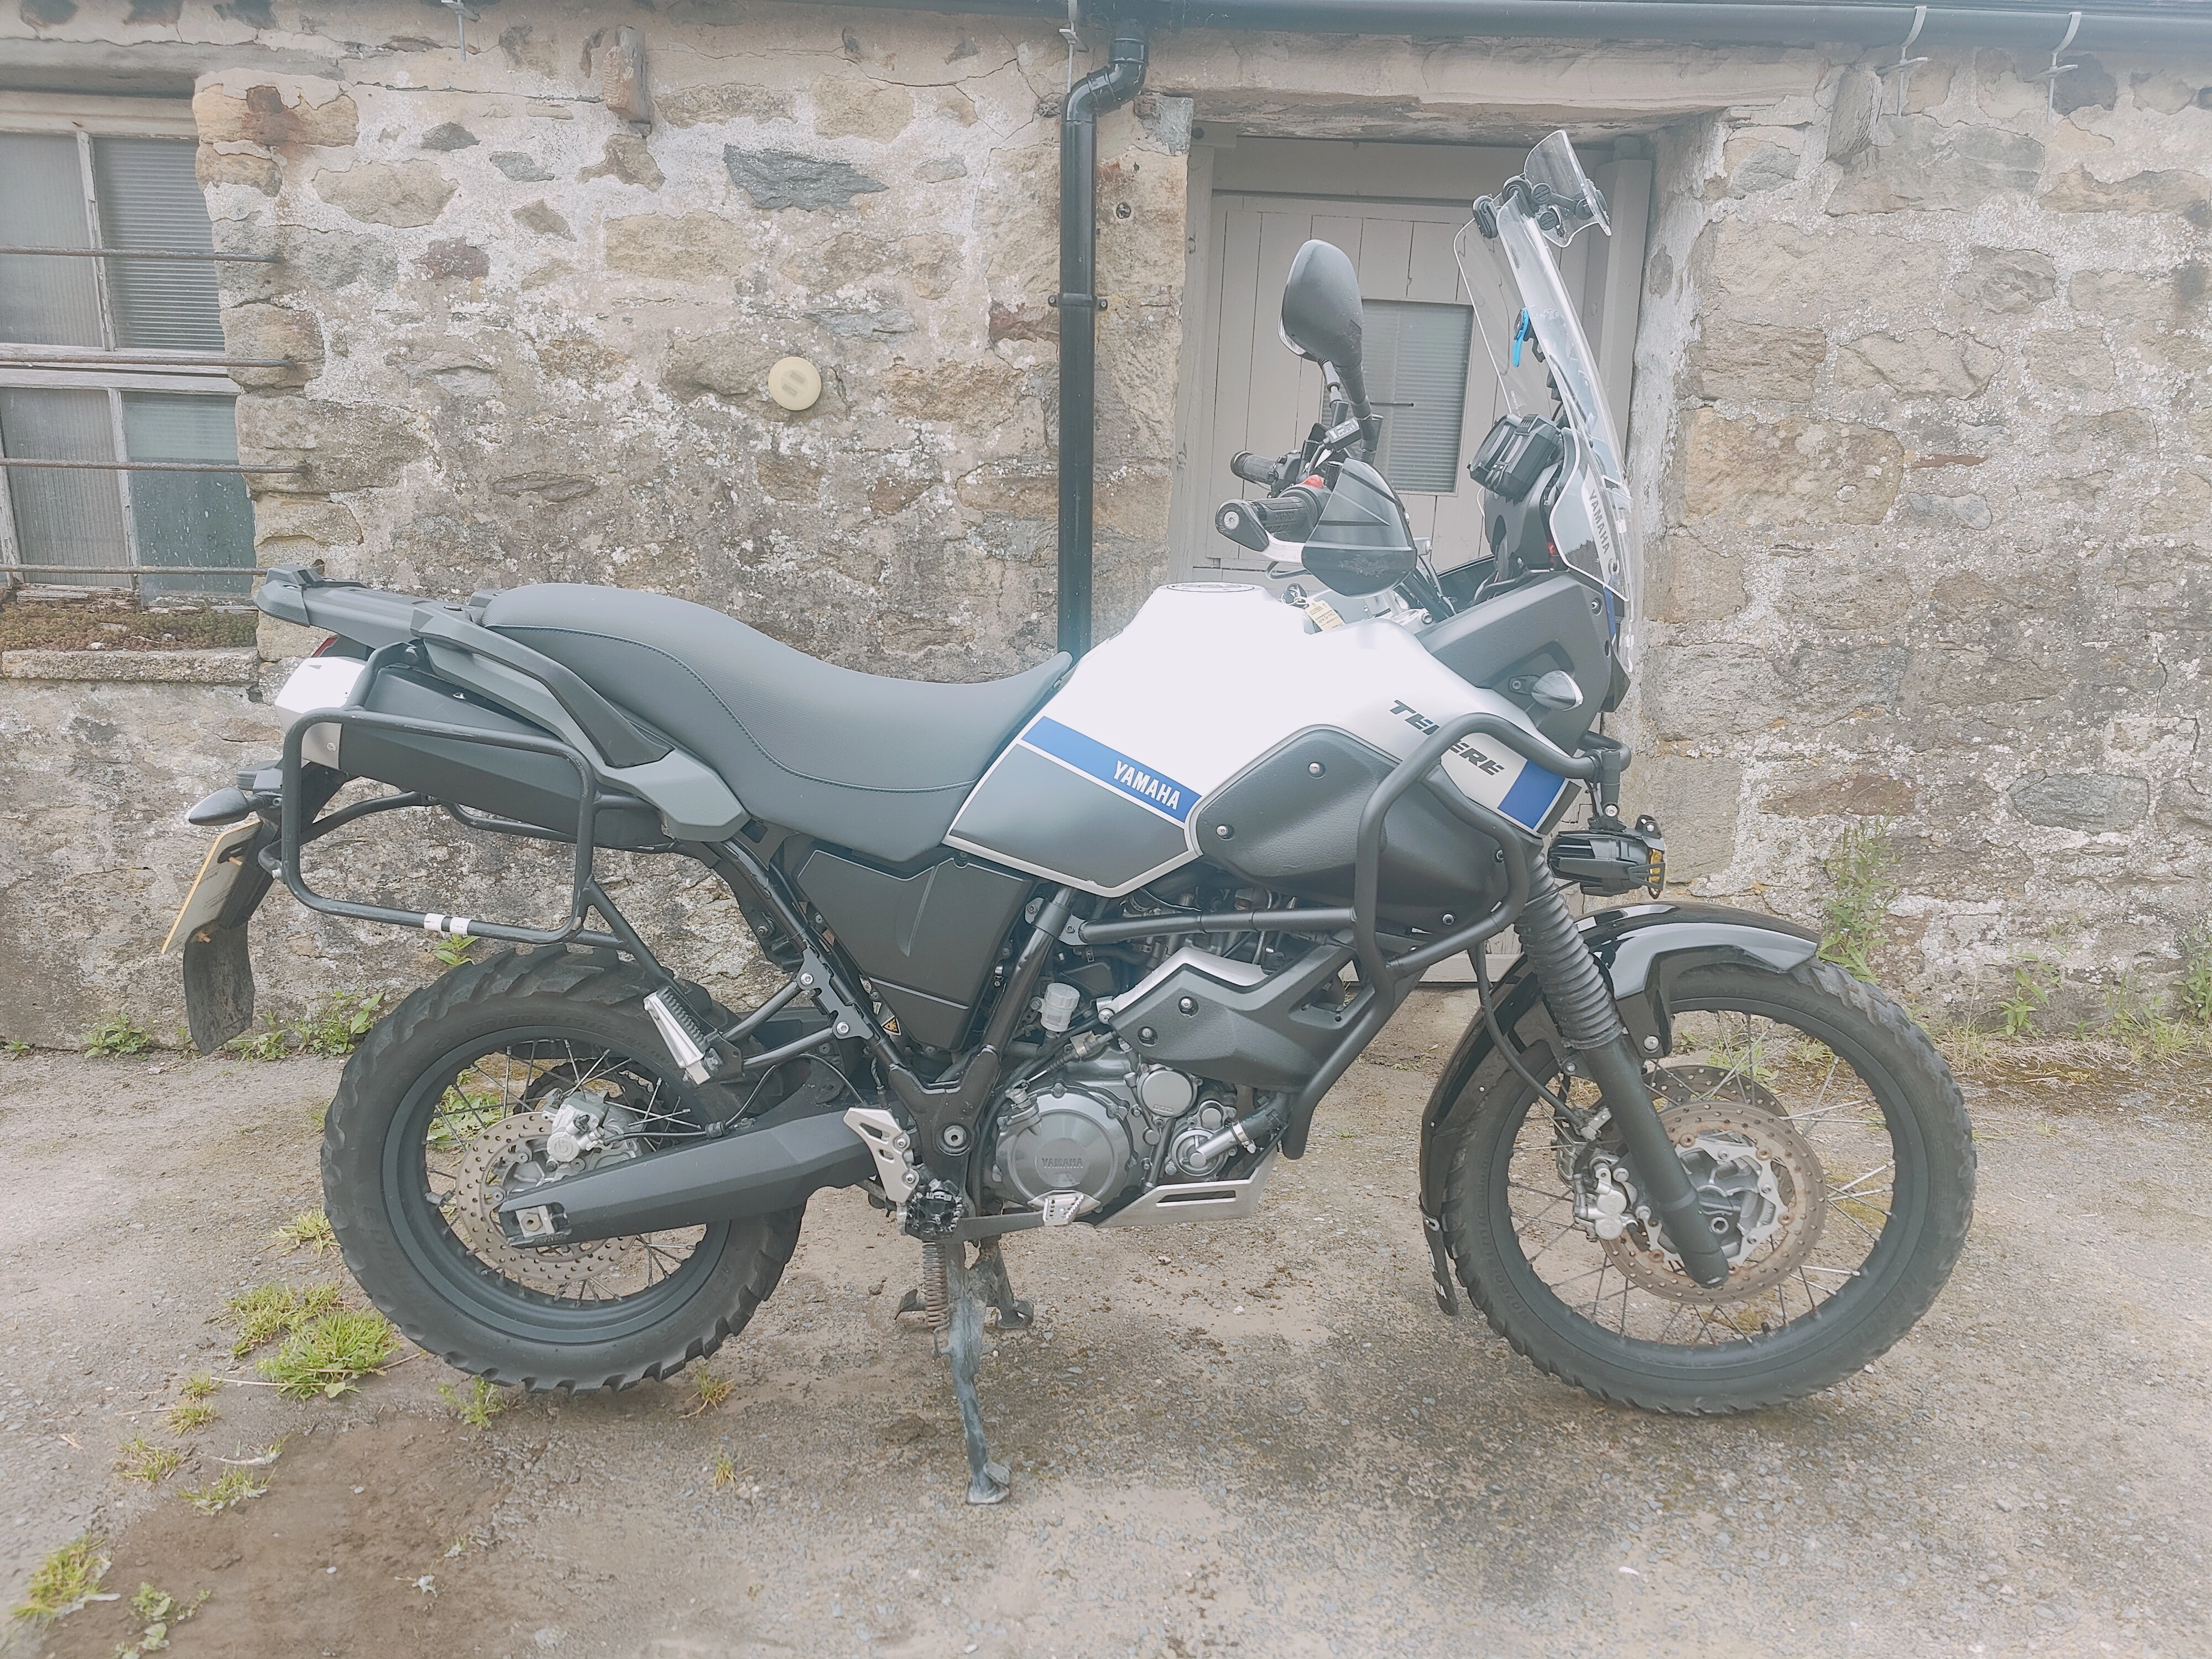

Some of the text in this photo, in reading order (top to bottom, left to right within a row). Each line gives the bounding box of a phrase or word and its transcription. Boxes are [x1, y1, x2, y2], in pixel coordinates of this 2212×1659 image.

[1588, 489, 1610, 555] YAMAHA
[1113, 760, 1181, 811] YAMAHA
[1041, 1158, 1084, 1168] YAMAHA
